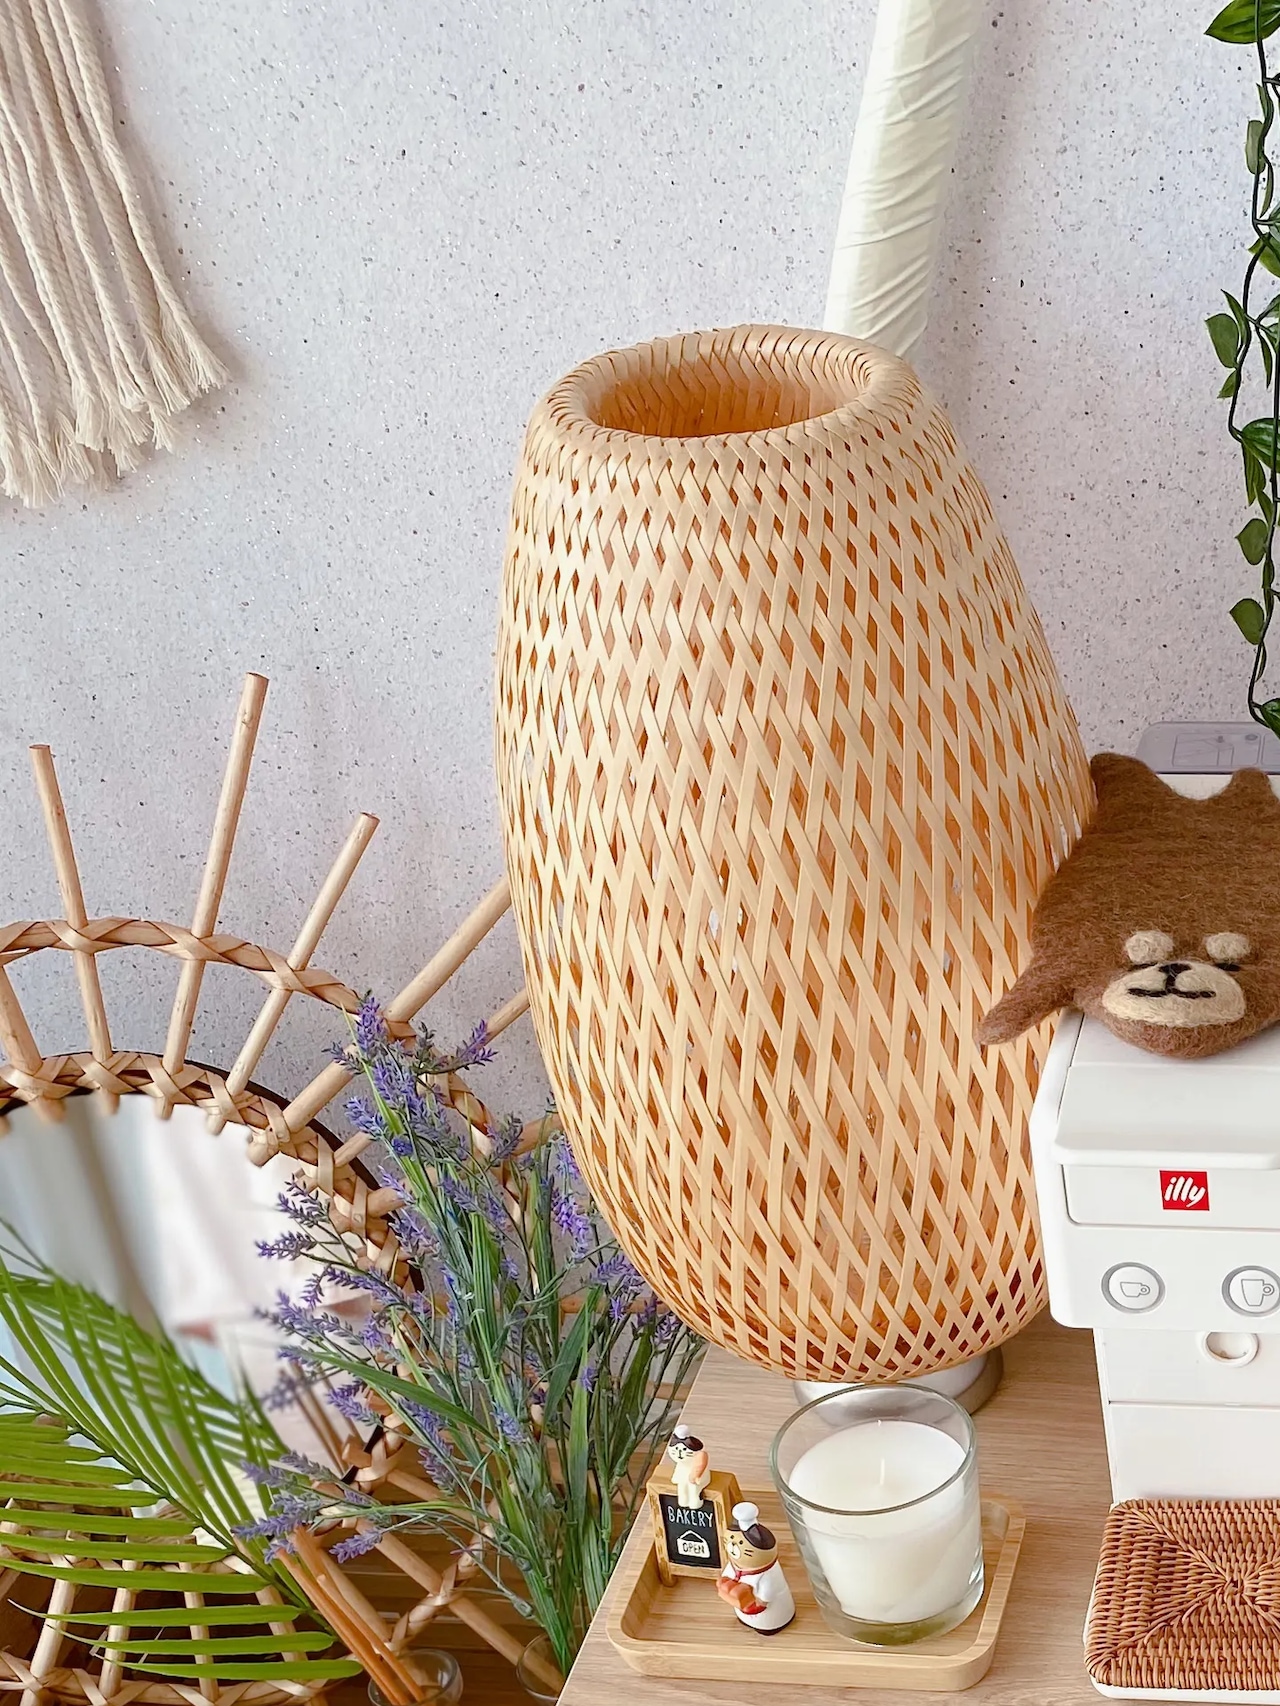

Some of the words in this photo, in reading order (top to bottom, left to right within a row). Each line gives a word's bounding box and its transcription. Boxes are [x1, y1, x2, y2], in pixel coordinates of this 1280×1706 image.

[1164, 1176, 1206, 1208] illy
[668, 1506, 713, 1528] BAKERY
[682, 1542, 704, 1554] OPEN
